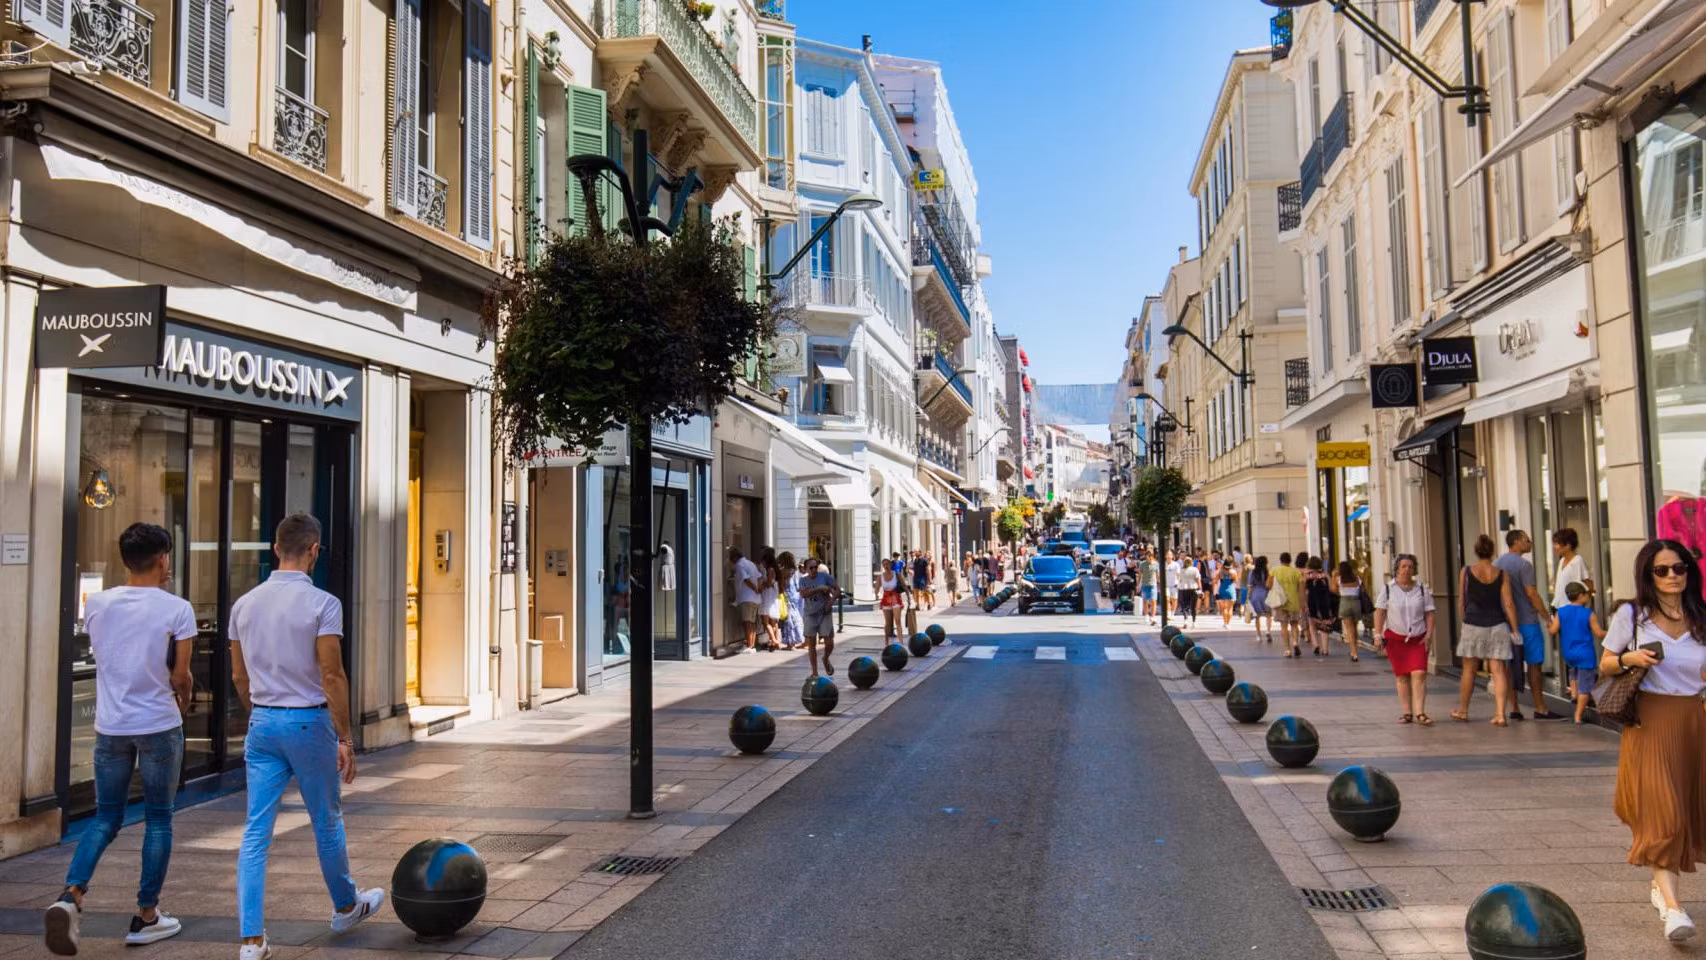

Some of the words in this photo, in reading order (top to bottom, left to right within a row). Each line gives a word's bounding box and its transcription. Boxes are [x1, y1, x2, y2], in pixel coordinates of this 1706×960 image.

[42, 312, 152, 330] MAUBOUSSIN
[1428, 351, 1472, 367] DJULA
[1319, 449, 1366, 461] BOCAGE
